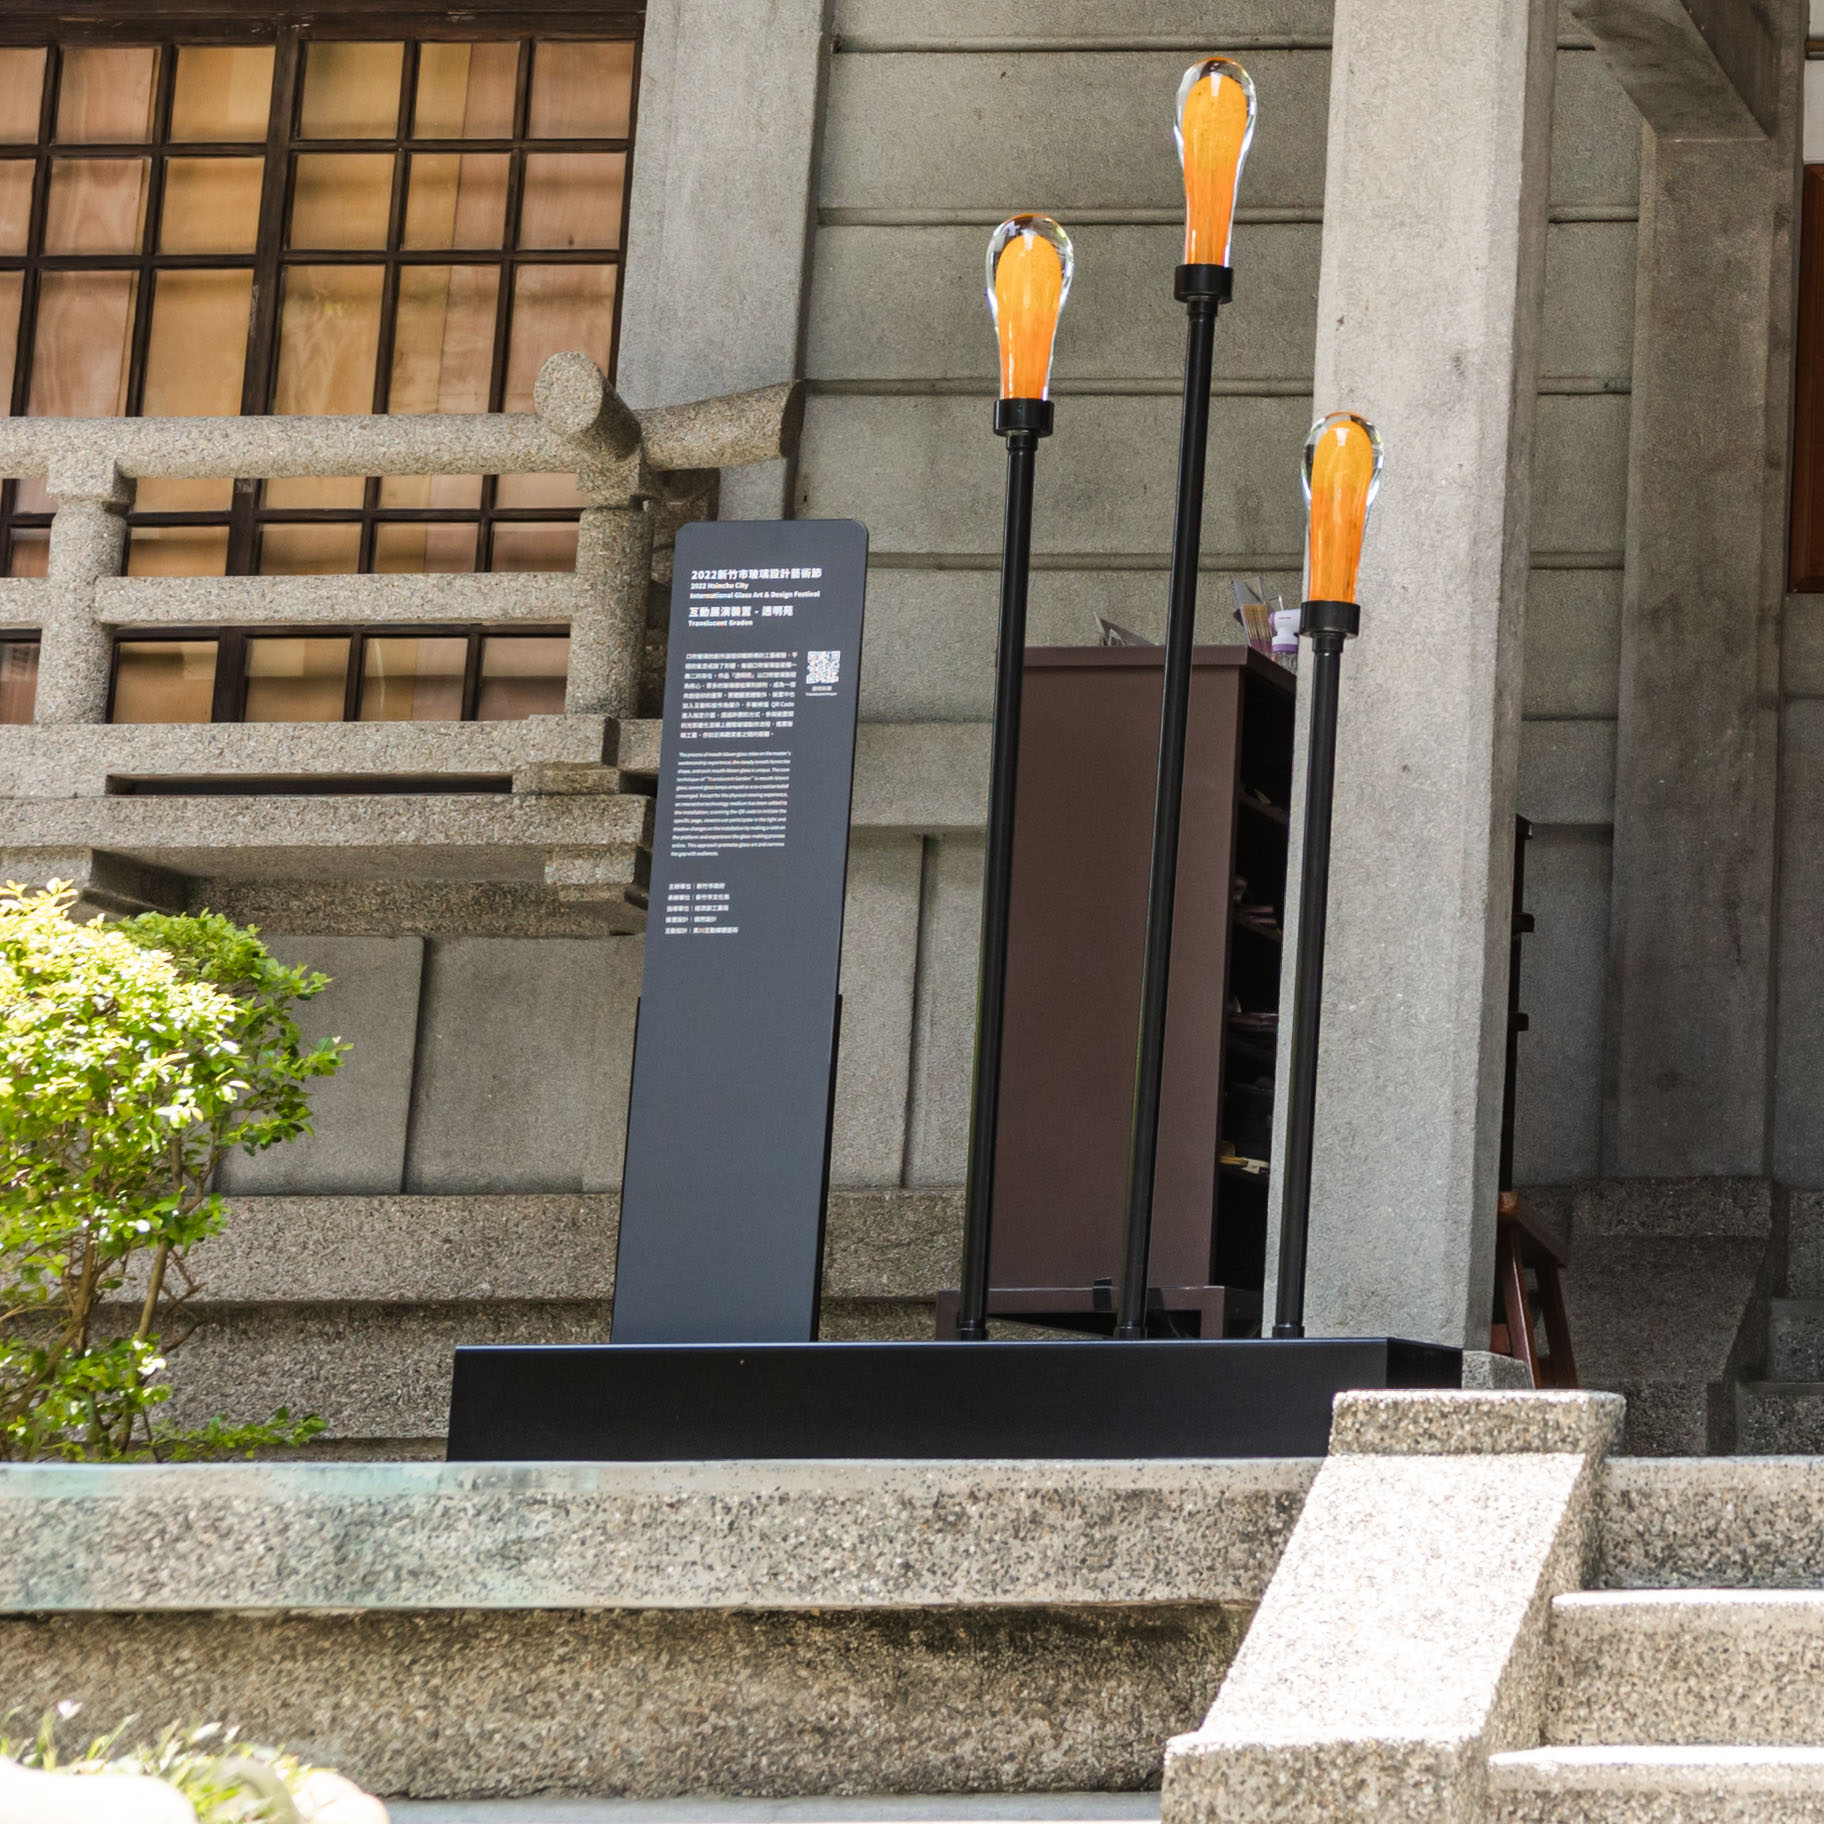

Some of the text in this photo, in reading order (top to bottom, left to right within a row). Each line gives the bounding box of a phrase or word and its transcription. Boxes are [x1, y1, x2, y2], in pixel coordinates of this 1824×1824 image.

[735, 582, 749, 590] City
[771, 591, 793, 599] Design
[793, 590, 821, 598] Festival
